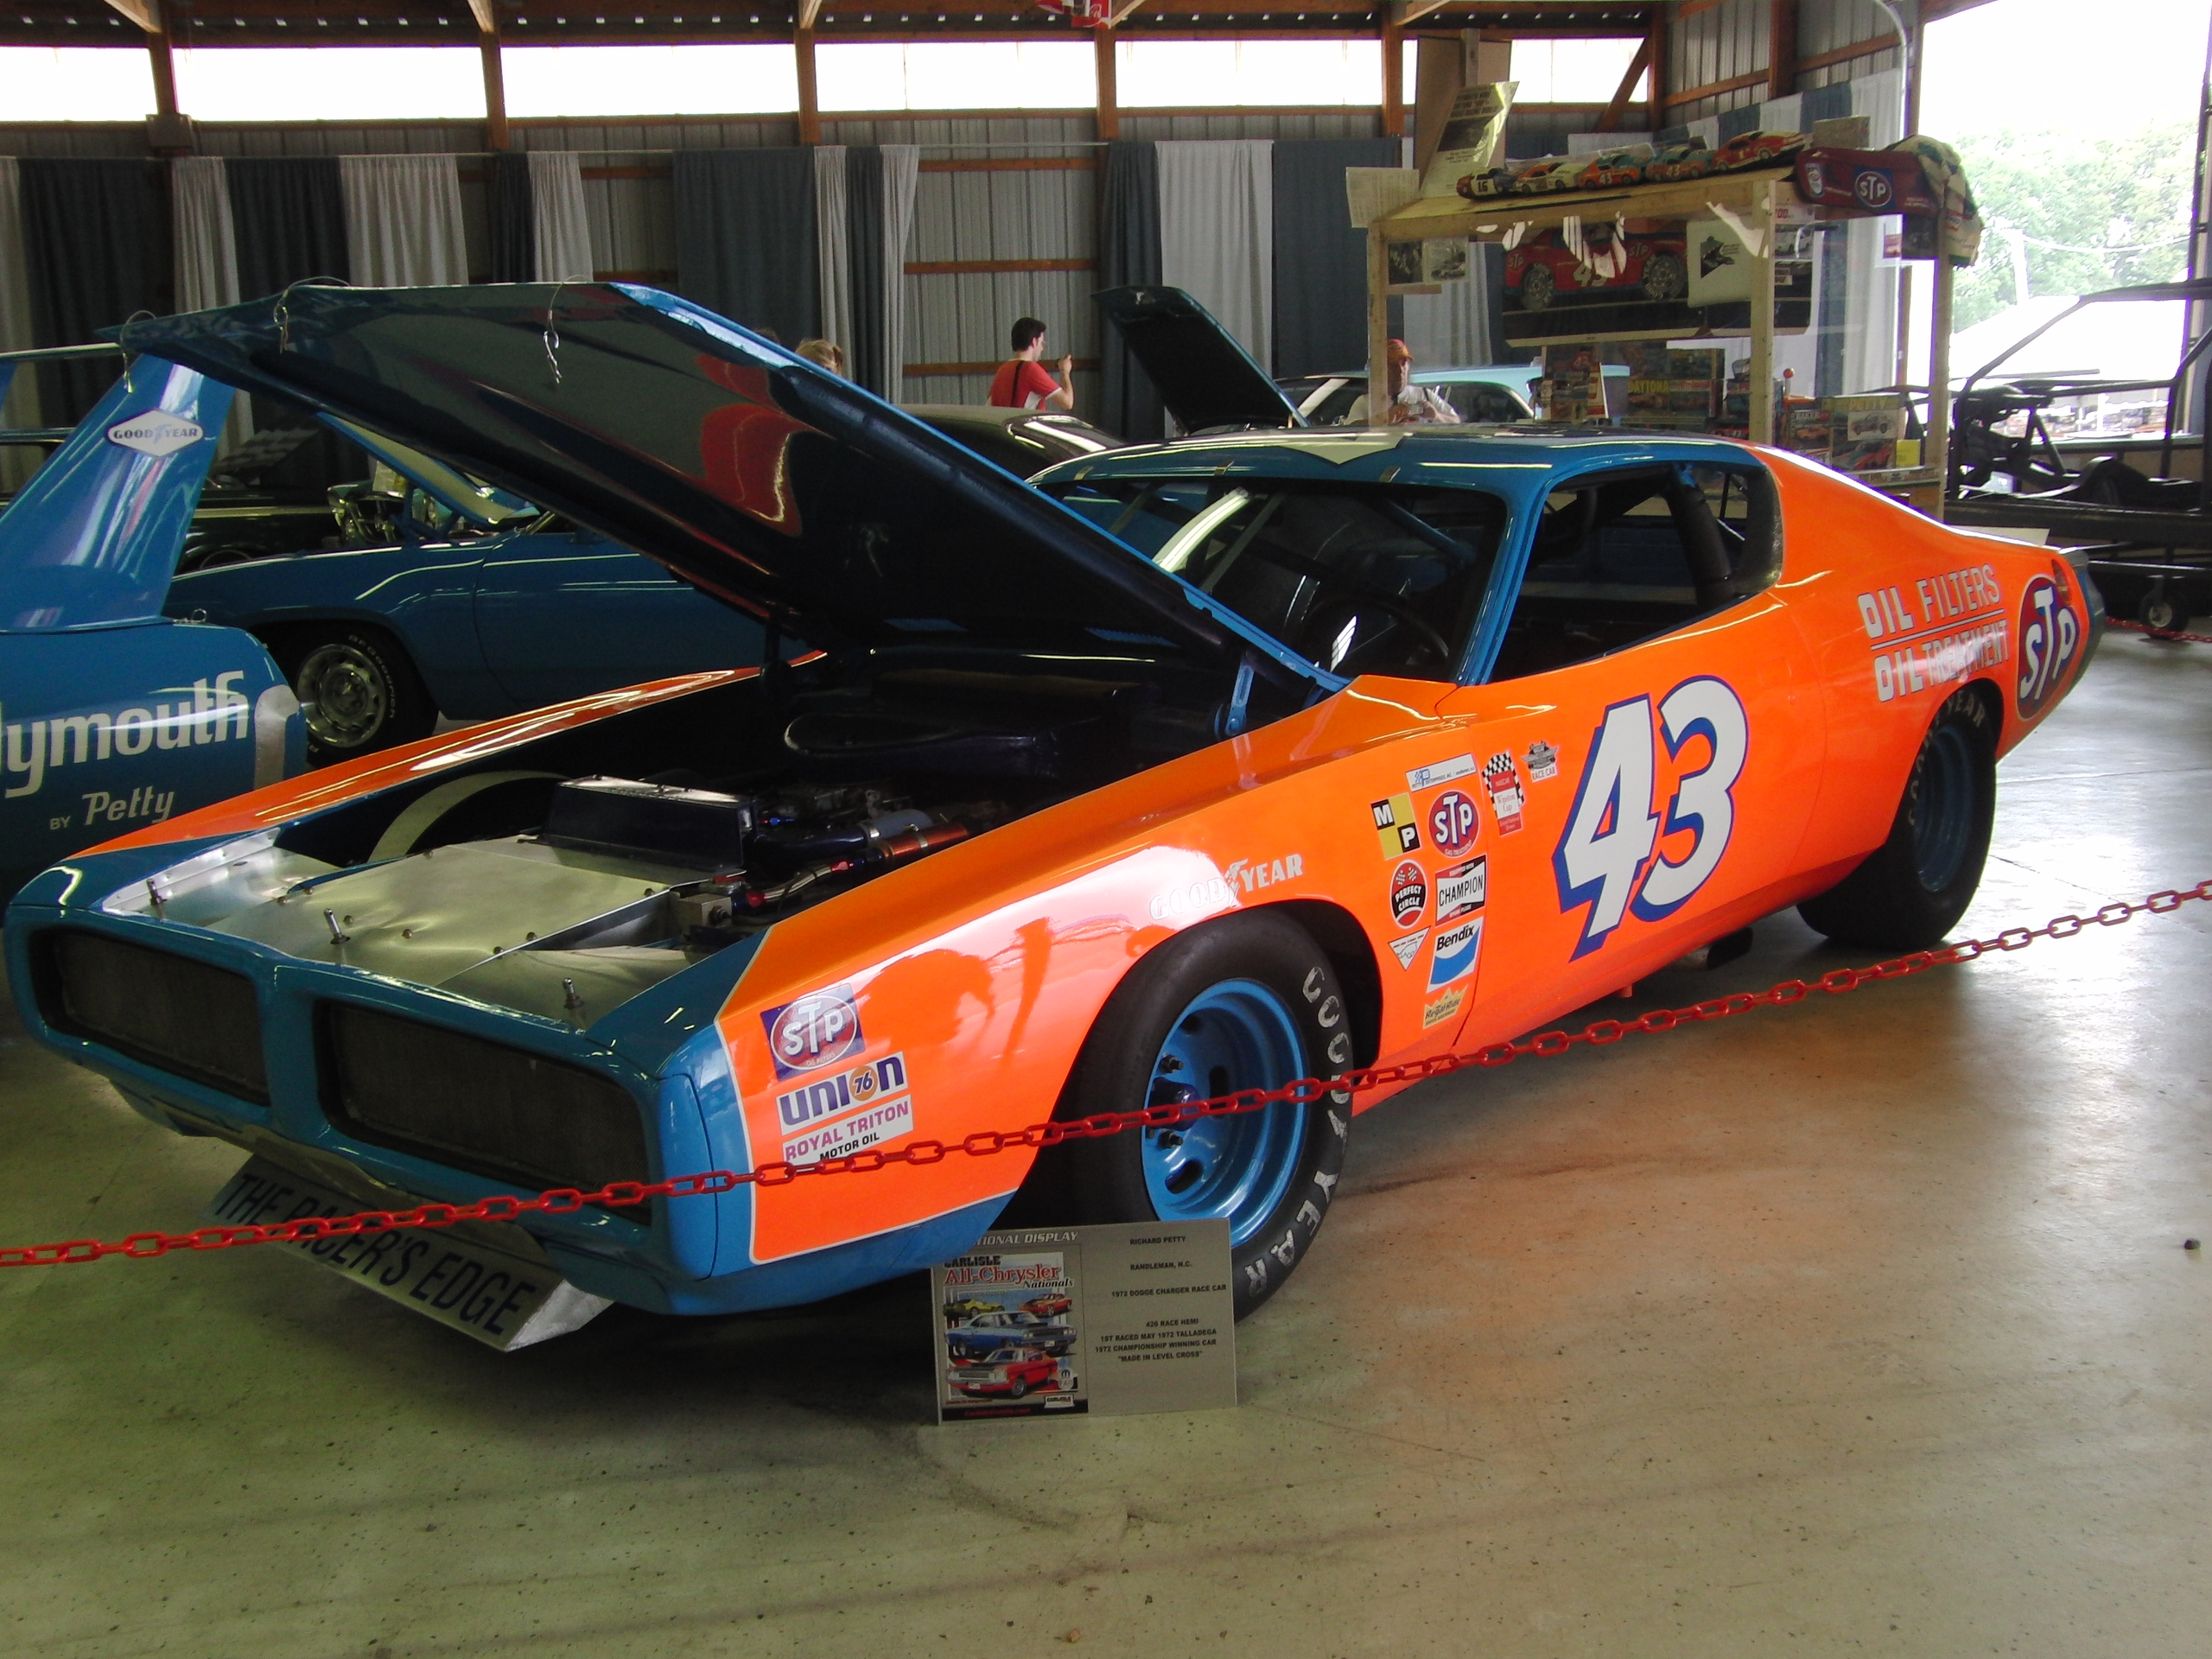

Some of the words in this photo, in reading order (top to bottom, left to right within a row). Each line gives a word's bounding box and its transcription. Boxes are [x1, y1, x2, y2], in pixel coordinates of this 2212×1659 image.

[1477, 180, 1490, 193] 16
[1599, 173, 1613, 185] 43
[1860, 175, 1887, 200] STP
[1628, 243, 1649, 258] STP
[1857, 585, 1915, 639] OIL
[1916, 563, 2002, 624] FILTERS
[2019, 586, 2078, 701] STP
[1873, 648, 1925, 703] OIL
[1921, 618, 2010, 688] TREATMENT
[0, 670, 250, 799] ymouth
[49, 815, 71, 830] BY
[81, 785, 175, 826] Petty
[1434, 793, 1473, 846] STP
[1553, 674, 1747, 963] 43
[1372, 804, 1395, 826] M
[1401, 827, 1416, 849] P
[1395, 885, 1422, 903] PERFECT
[1439, 874, 1484, 907] CHAMPION
[1397, 897, 1421, 912] CIRCLE
[1436, 925, 1475, 951] Bendix
[782, 1001, 844, 1056] STP
[853, 1071, 874, 1096] 76
[785, 1127, 843, 1162] ROYAL
[847, 1100, 909, 1136] TRITON
[819, 1139, 860, 1160] MOTOR
[862, 1131, 880, 1146] OIL
[974, 1234, 1020, 1246] TIONAL
[1024, 1231, 1078, 1243] DISPLAY
[214, 1173, 294, 1225] THE
[409, 1250, 537, 1336] EDGE
[1130, 1262, 1176, 1270] RANDLEMAN,
[944, 1263, 1061, 1285] All-Chrysler
[1022, 1277, 1074, 1289] Nationals
[1129, 1288, 1154, 1297] DODGE
[1155, 1287, 1190, 1295] CHARGER
[1113, 1342, 1167, 1351] CHAMPIONSHIP
[1168, 1340, 1200, 1349] WINNING
[1176, 1328, 1217, 1338] TALLADEGA
[1152, 1351, 1174, 1360] LEVEL
